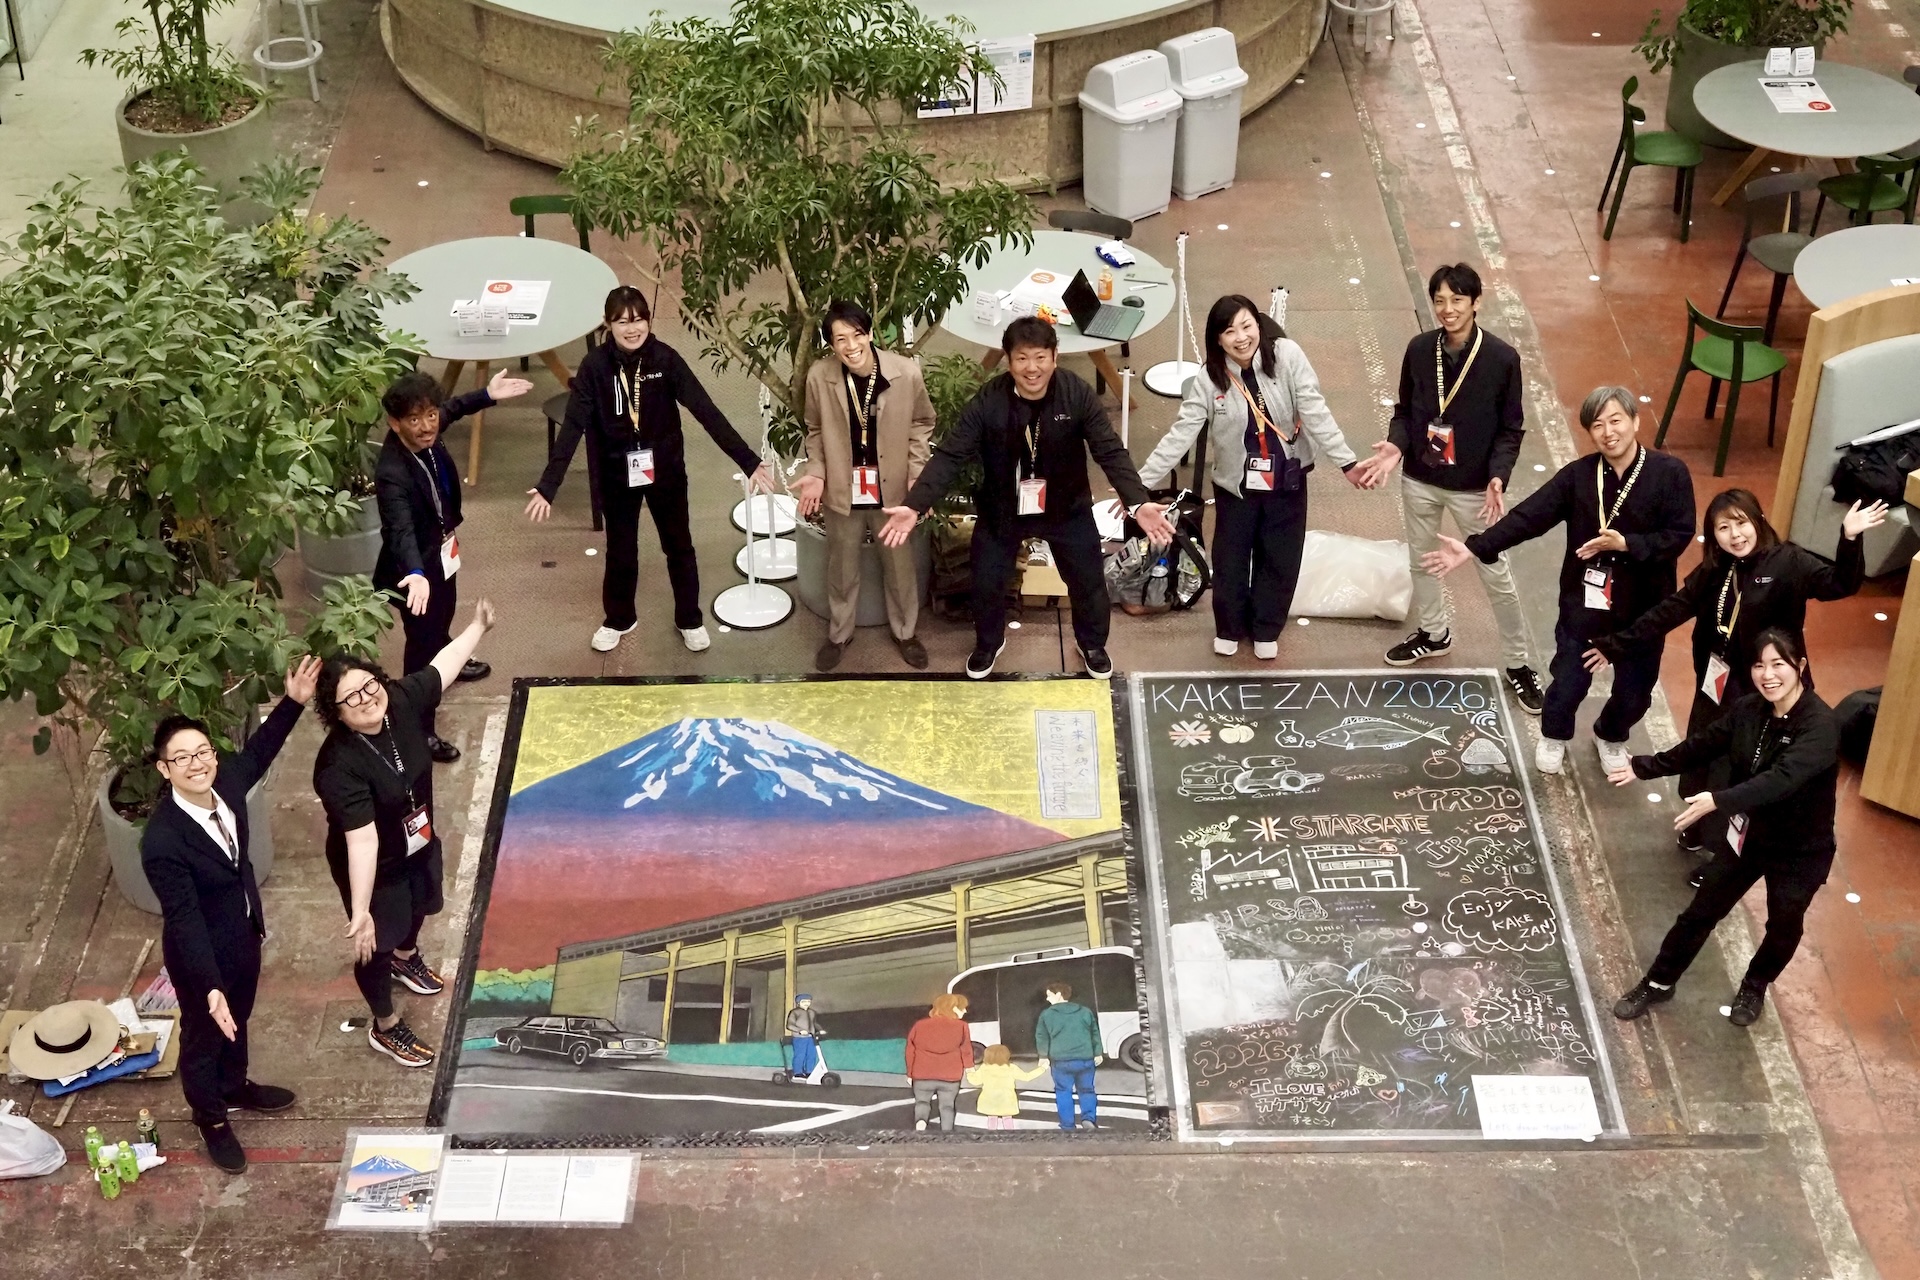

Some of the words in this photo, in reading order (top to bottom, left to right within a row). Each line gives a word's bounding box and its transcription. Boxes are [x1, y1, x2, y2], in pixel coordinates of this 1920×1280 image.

[1382, 680, 1485, 709] 2026
[1418, 785, 1523, 812] PROTO
[1290, 813, 1433, 839] STARGATE
[1461, 840, 1505, 873] WOVEN
[1483, 838, 1530, 875] CAPITAL
[1462, 899, 1513, 918] Enjoy
[1492, 914, 1533, 931] KAKE
[1520, 919, 1550, 938] ZAN
[1193, 1040, 1288, 1077] 2026
[1274, 1082, 1326, 1096] LOVE
[1255, 1098, 1331, 1115] カケザン
